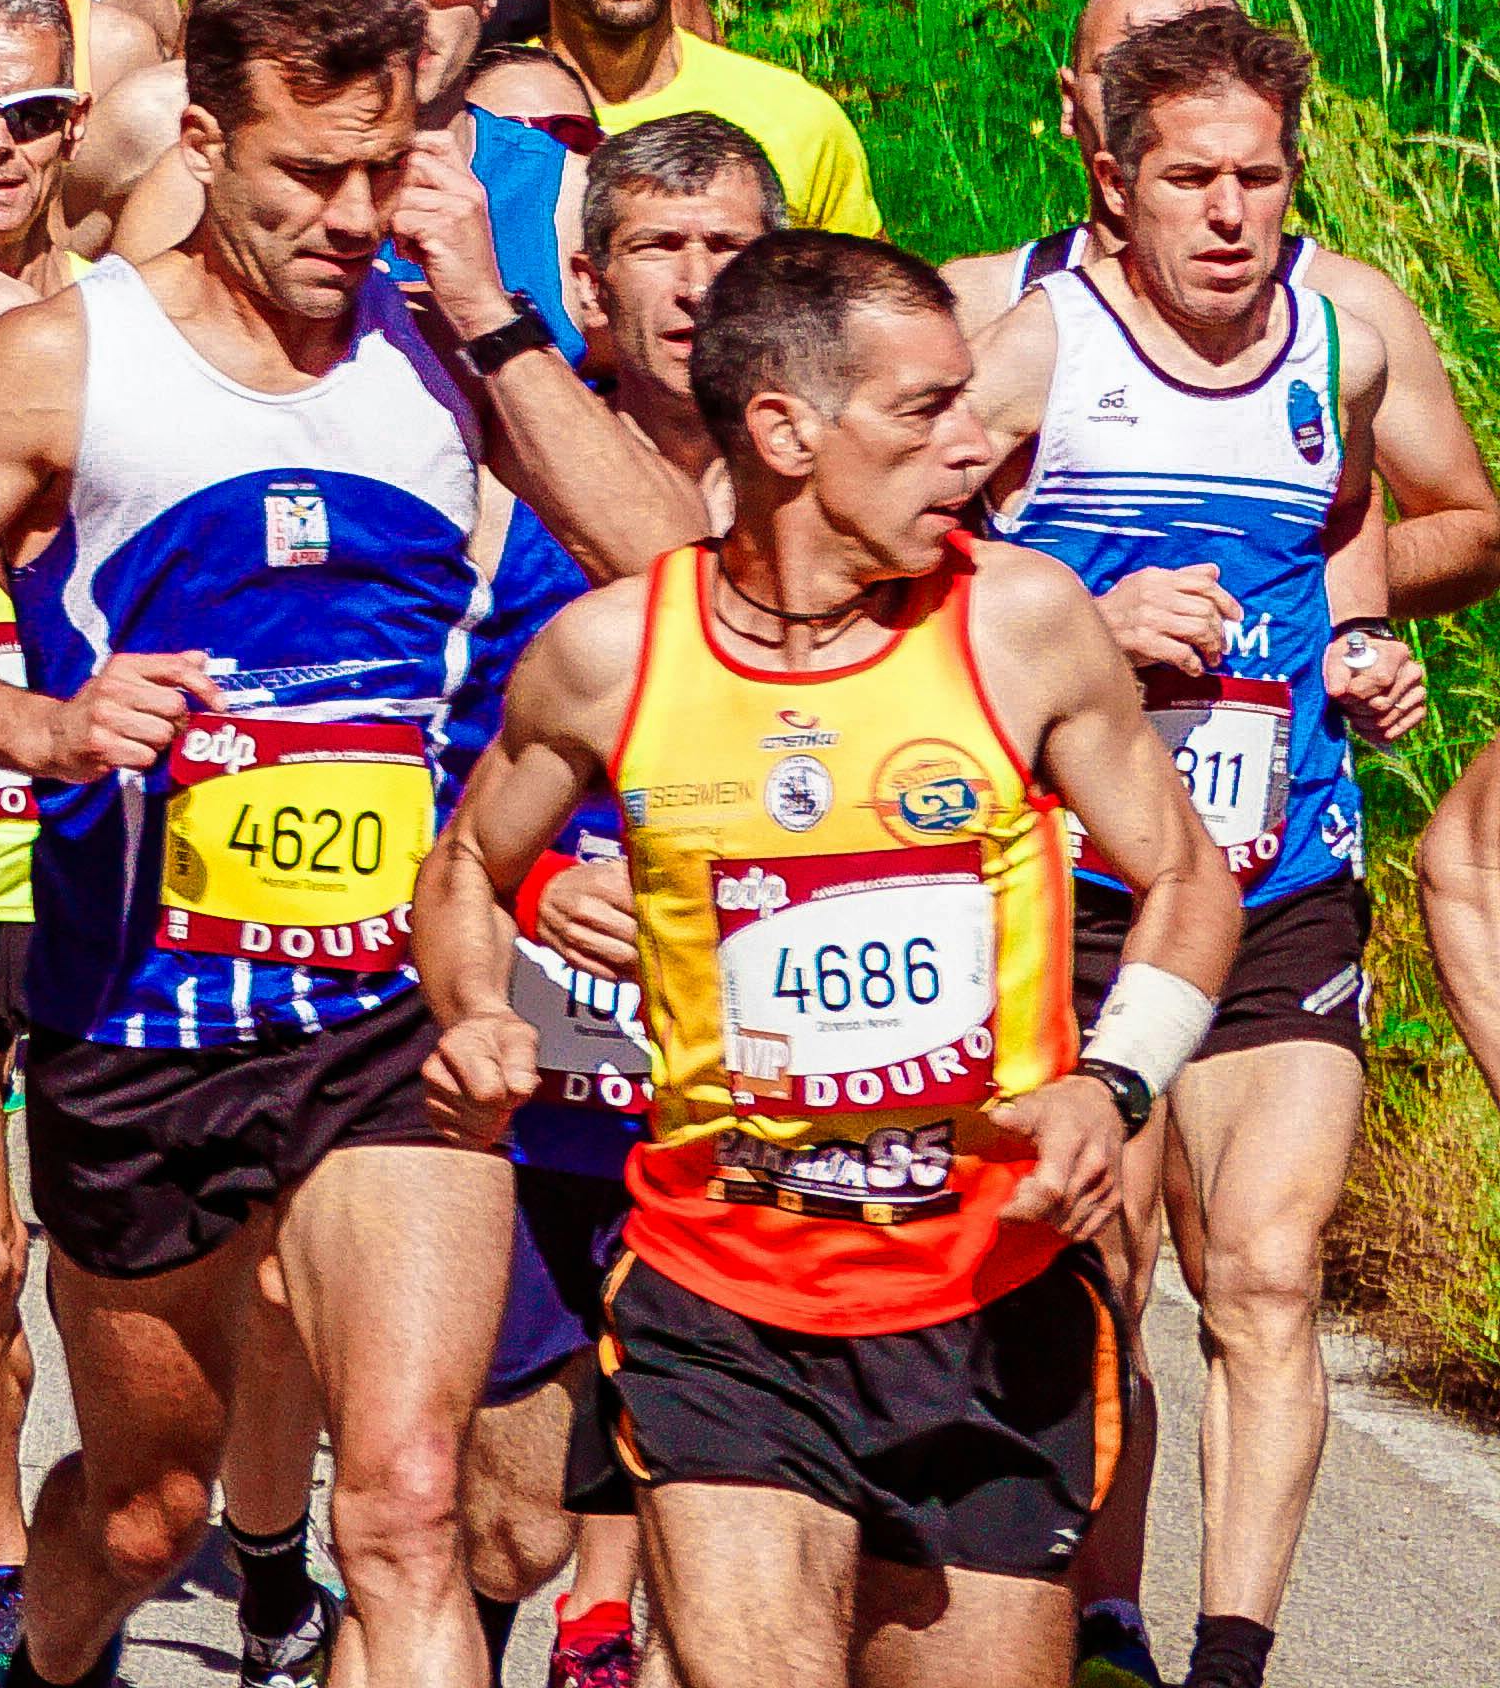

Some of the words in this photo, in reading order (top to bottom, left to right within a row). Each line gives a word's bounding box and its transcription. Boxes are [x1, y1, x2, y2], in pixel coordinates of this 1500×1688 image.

[181, 723, 257, 774] edp
[229, 803, 384, 876] 4620
[772, 937, 941, 1014] 4686
[804, 1024, 994, 1108] DOURO
